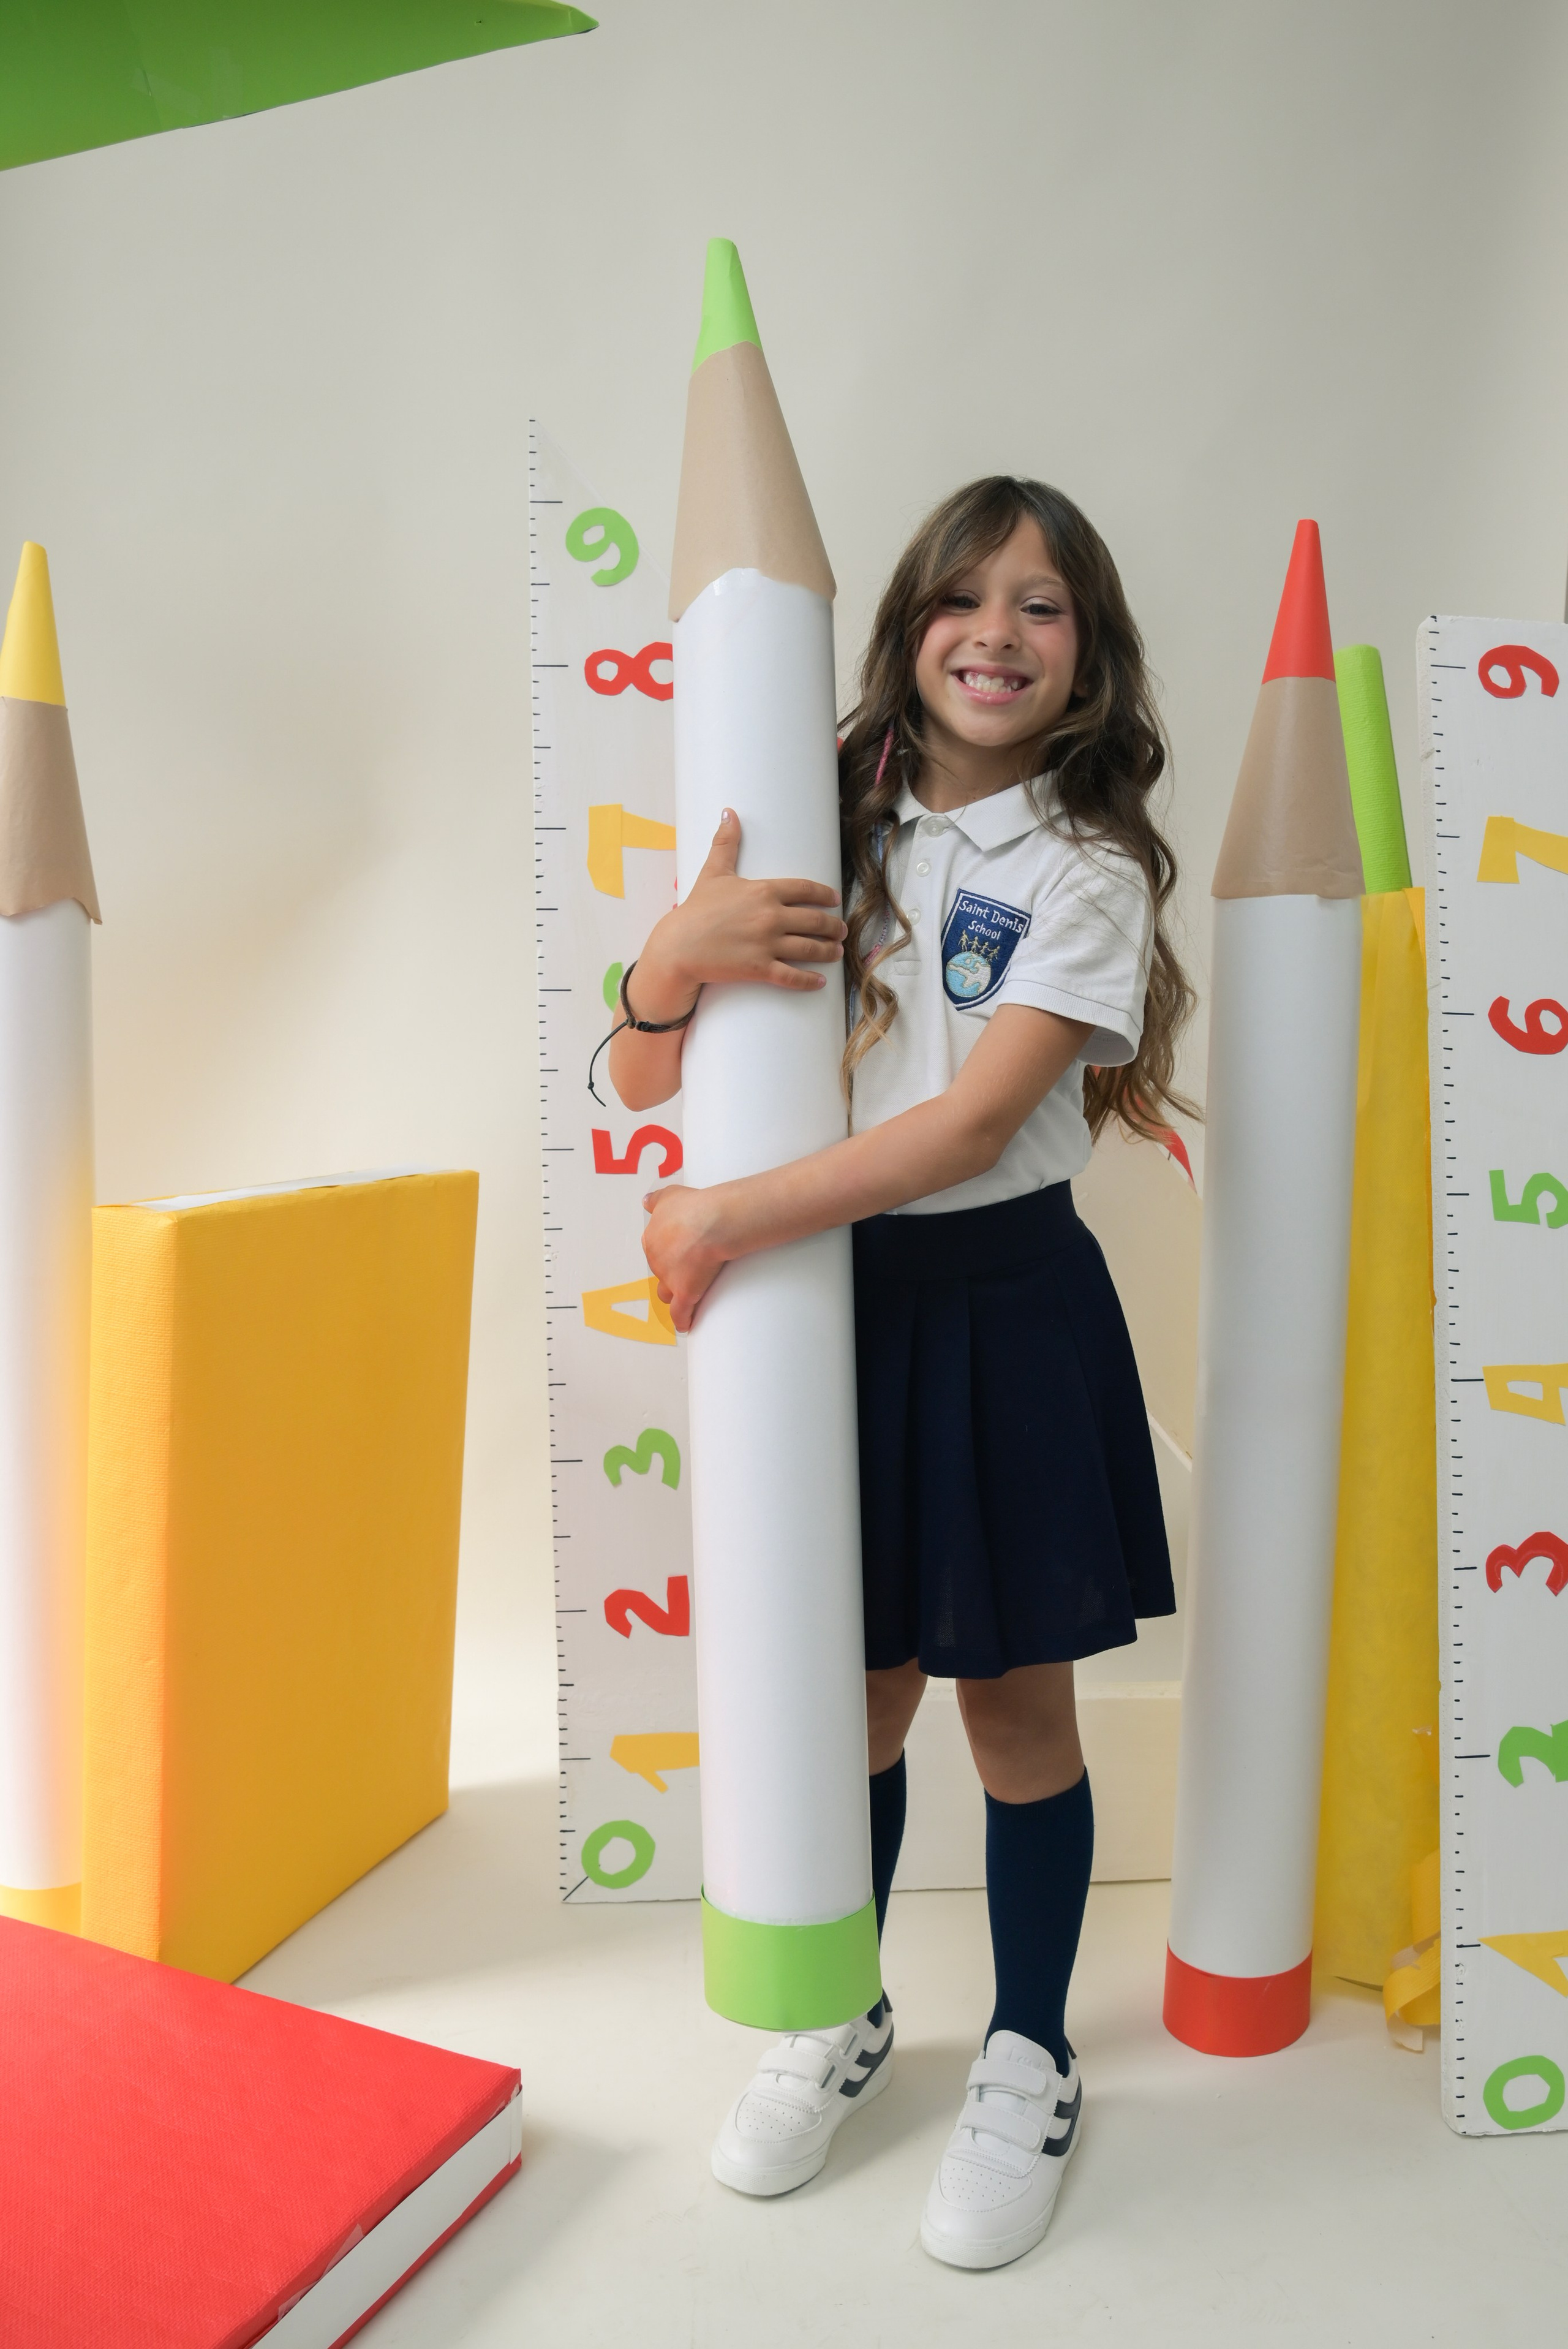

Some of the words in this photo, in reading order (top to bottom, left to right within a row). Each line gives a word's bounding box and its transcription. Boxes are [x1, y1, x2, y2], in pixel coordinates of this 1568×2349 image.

[566, 507, 639, 586] 9
[584, 641, 674, 702] 8
[1478, 645, 1559, 698] 9
[586, 803, 677, 899] 7
[1477, 815, 1568, 884] 7
[959, 900, 990, 919] Saint
[990, 910, 1024, 933] Denis
[968, 920, 1001, 940] School
[1488, 996, 1568, 1055] 6
[591, 1124, 684, 1179] 5
[1489, 1169, 1568, 1229] 5
[603, 1428, 681, 1490] 3
[1485, 1530, 1568, 1596] 3
[603, 1575, 690, 1639] 2
[609, 1732, 701, 1794] 1
